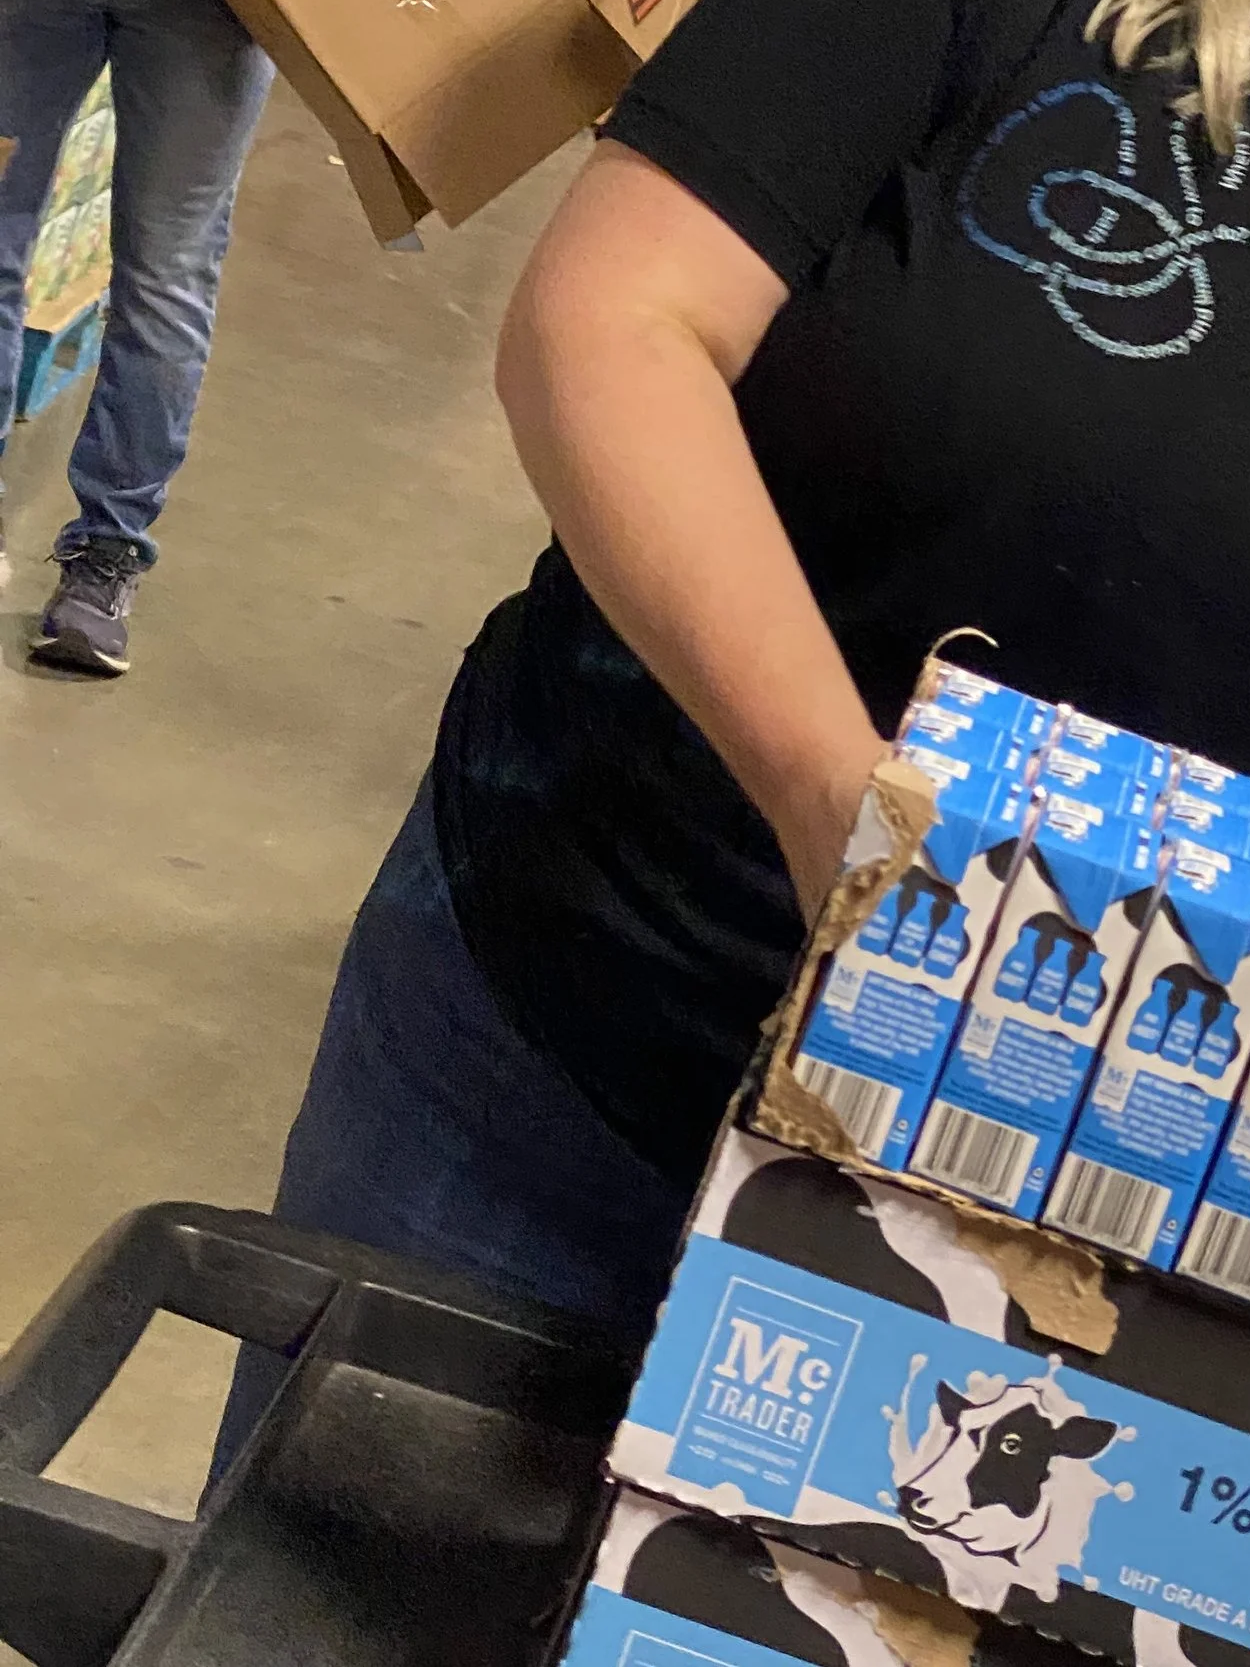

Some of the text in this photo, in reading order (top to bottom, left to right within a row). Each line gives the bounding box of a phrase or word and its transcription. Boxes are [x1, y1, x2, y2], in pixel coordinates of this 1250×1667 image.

[706, 1380, 814, 1445] TRADER
[1119, 1565, 1161, 1595] UHT
[1161, 1583, 1233, 1622] GRADE
[1231, 1610, 1247, 1630] A
